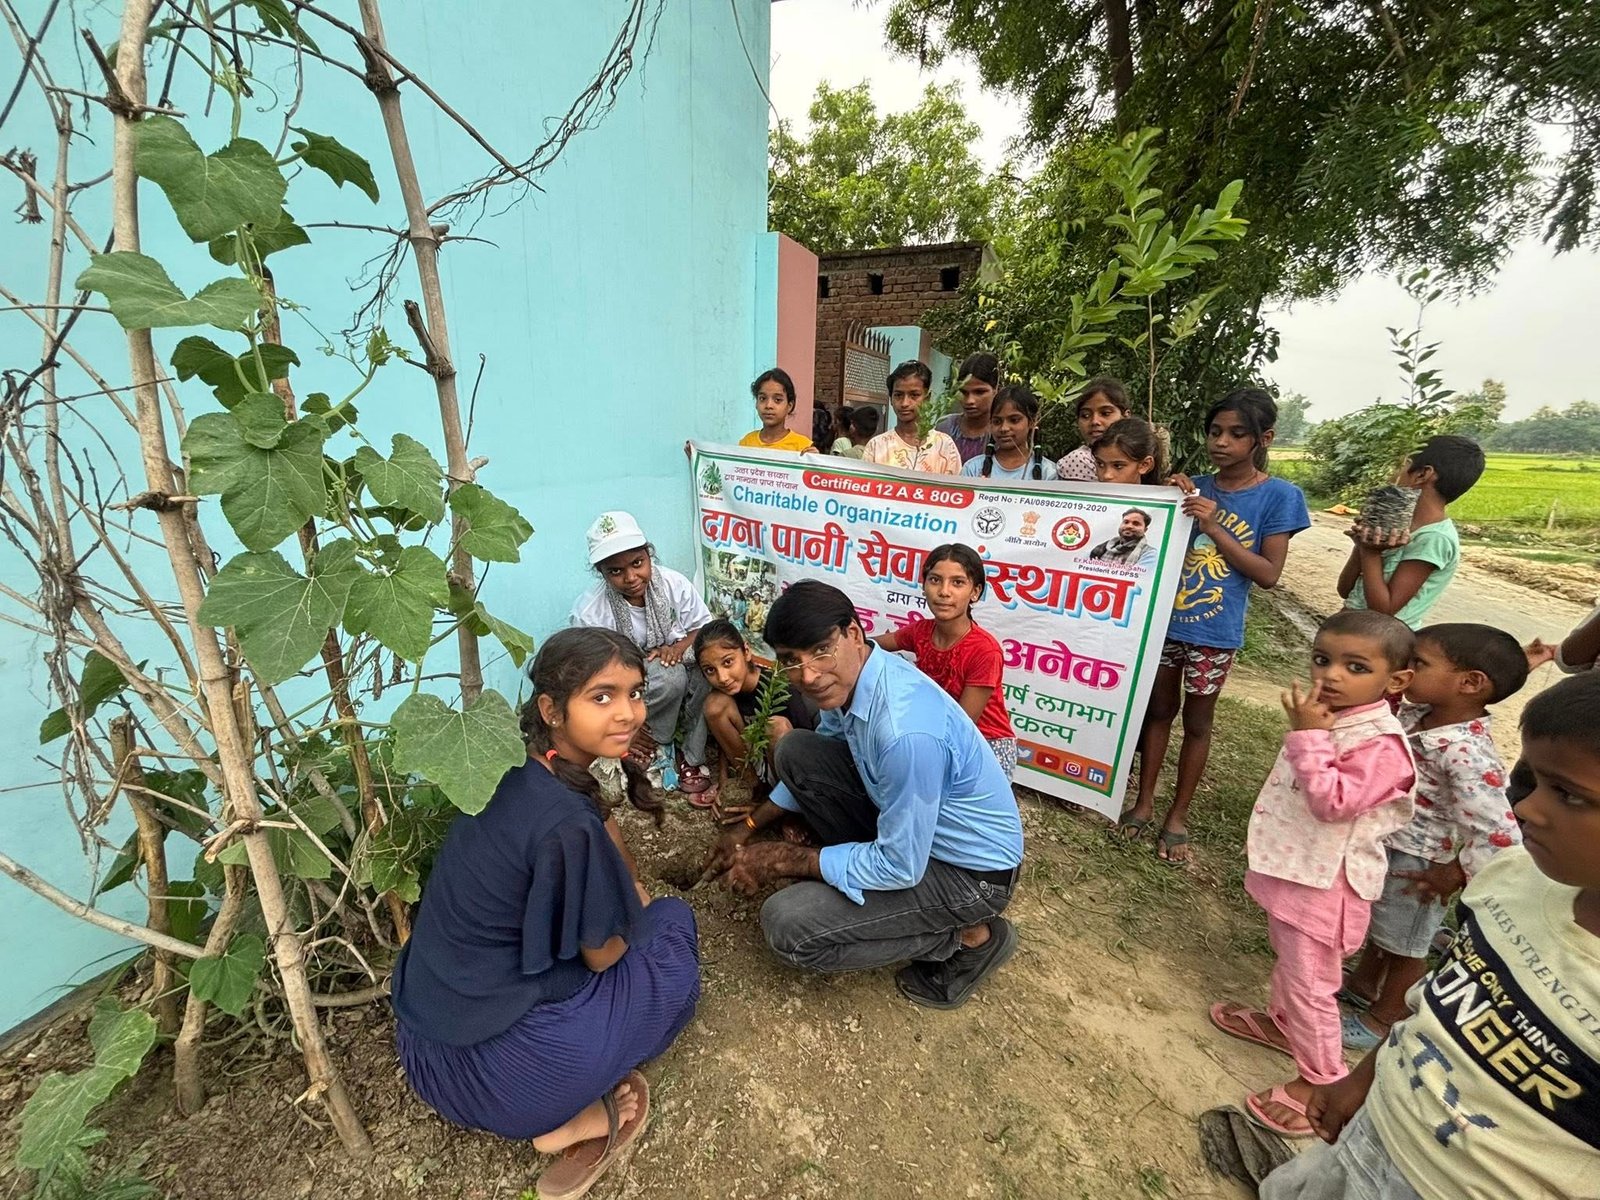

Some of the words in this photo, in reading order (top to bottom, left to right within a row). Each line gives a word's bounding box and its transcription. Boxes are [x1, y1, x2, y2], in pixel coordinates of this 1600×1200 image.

[767, 470, 790, 480] सरकार
[810, 474, 871, 493] Certified
[876, 483, 893, 496] 12
[896, 486, 909, 498] A
[912, 488, 925, 500] &
[930, 490, 964, 505] 80G
[733, 485, 819, 513] Charitable
[824, 498, 958, 535] Organization
[978, 493, 1000, 503] Regd
[1001, 495, 1012, 503] No
[701, 508, 765, 552] दाना
[770, 521, 851, 570] पानी
[977, 544, 1139, 624] ंस्थान
[1078, 564, 1110, 575] President
[886, 590, 912, 606] द्वारा
[1001, 638, 1126, 689] अनेक
[1008, 707, 1078, 744] ंकल्प
[1034, 692, 1118, 728] लगभग
[1430, 958, 1582, 1113] ONGER
[1480, 972, 1514, 1009] ONLY
[1510, 1010, 1571, 1066] THING
